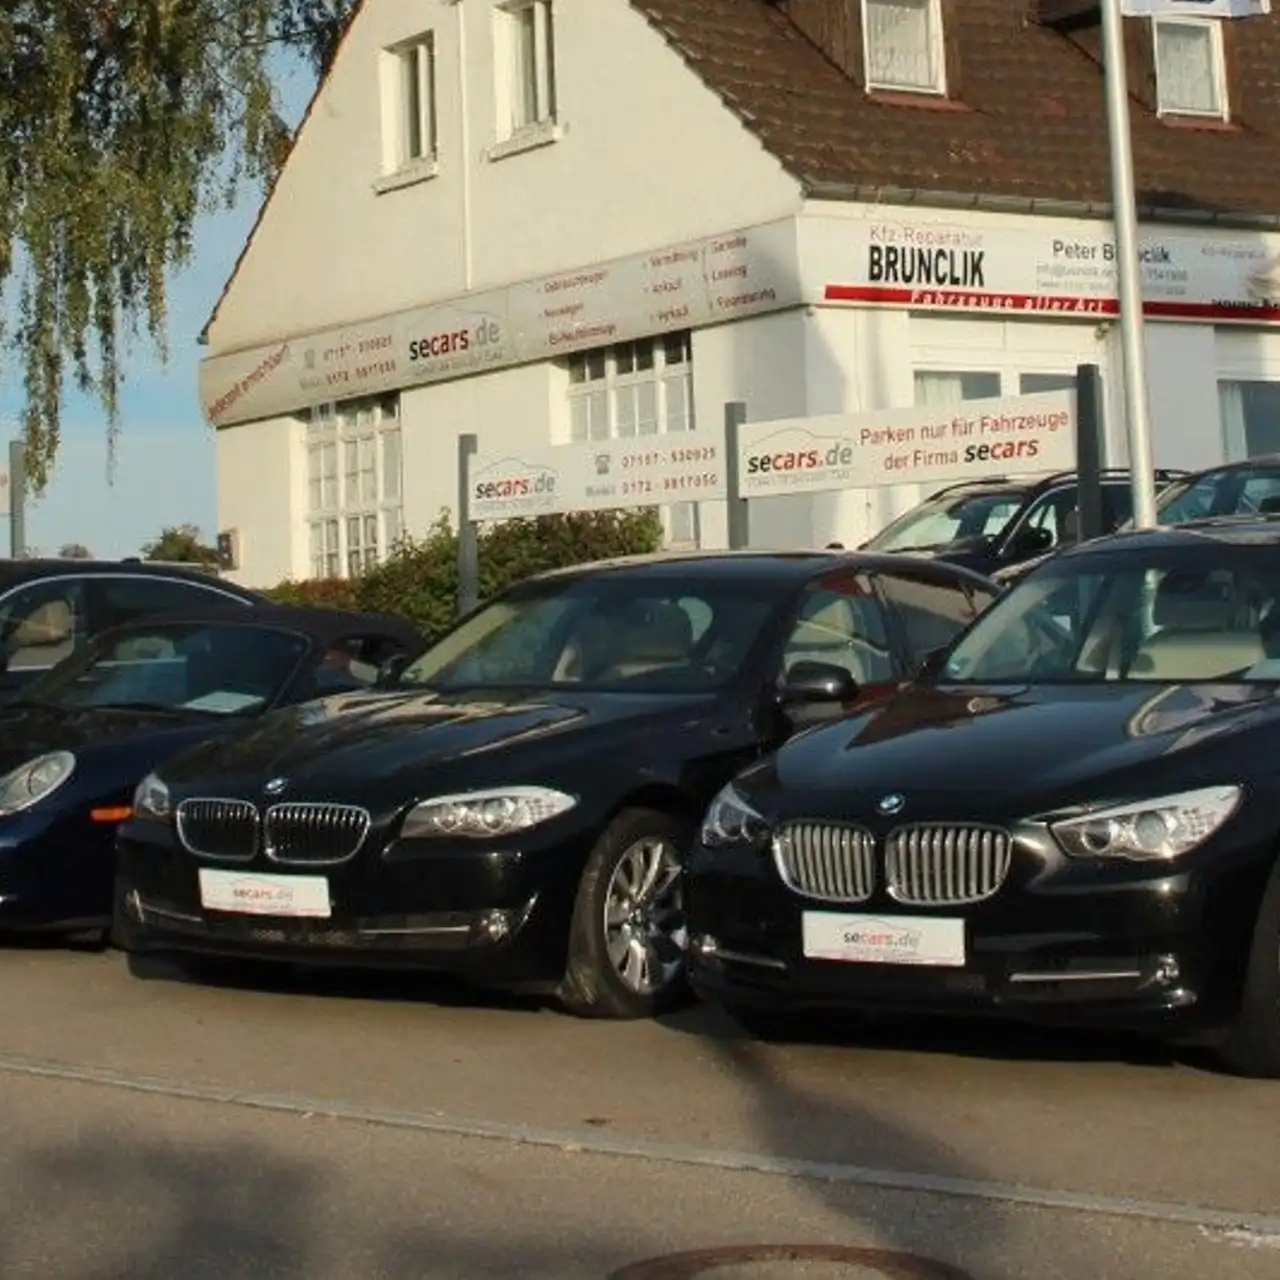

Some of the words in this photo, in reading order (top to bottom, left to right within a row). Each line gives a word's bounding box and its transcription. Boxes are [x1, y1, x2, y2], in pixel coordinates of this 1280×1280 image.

[870, 225, 984, 247] Kfz-Reparatur
[1053, 240, 1097, 261] Peter
[869, 245, 985, 287] BRUNCLIK
[910, 291, 1014, 311] Fahrzeuge
[409, 317, 501, 361] secars.de
[861, 428, 915, 447] Parken
[921, 424, 946, 440] nur
[952, 417, 974, 437] für
[980, 411, 1069, 433] Fahrzeuge
[748, 444, 853, 475] secars.de
[884, 452, 910, 471] der
[913, 449, 959, 469] Firma
[964, 437, 1040, 464] secars
[475, 472, 556, 499] secars.de
[844, 931, 920, 948] secars.de
